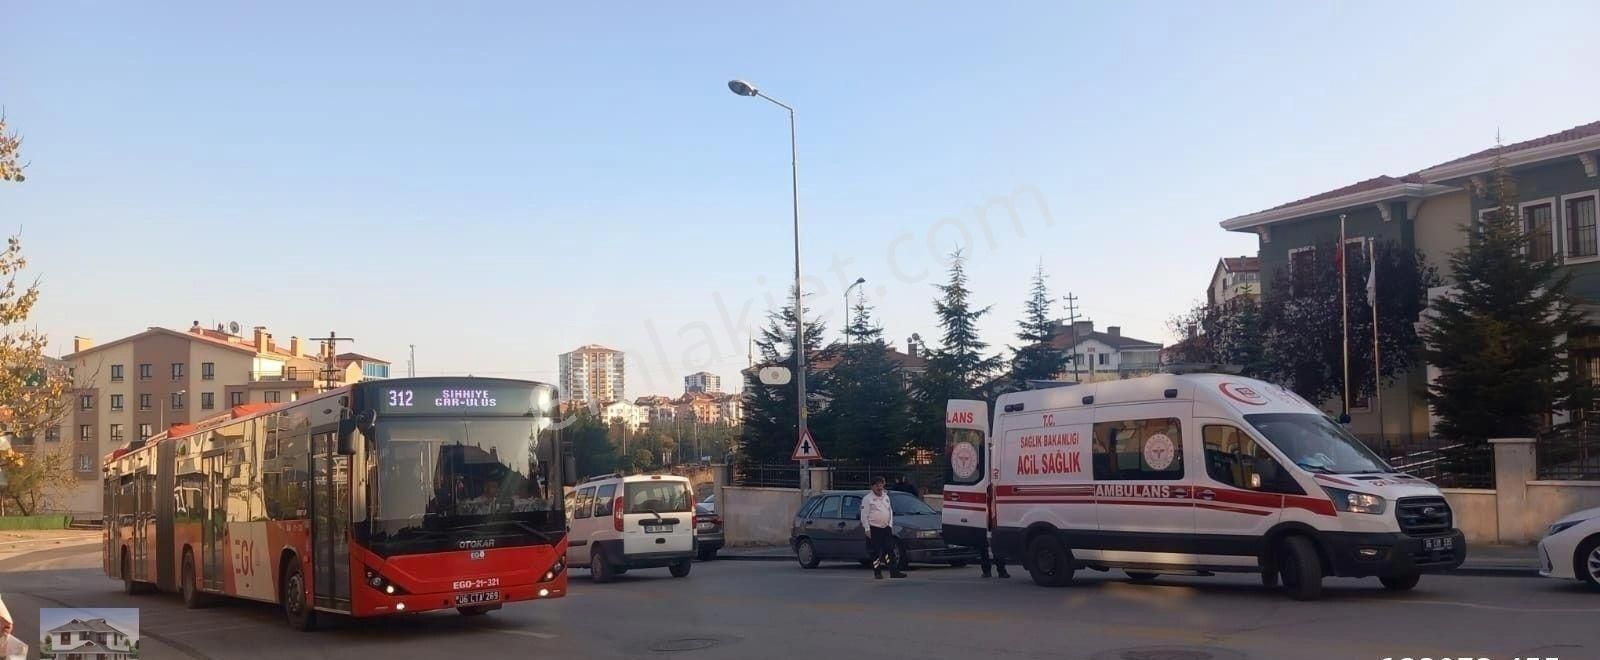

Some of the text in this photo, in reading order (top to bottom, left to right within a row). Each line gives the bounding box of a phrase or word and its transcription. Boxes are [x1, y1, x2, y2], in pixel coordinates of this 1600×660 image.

[389, 389, 414, 407] 312
[1041, 450, 1081, 474] SAĞLIK
[1095, 484, 1170, 498] AMBULANS
[459, 539, 495, 549] OTOKAR
[453, 578, 500, 590] EGO-21-321
